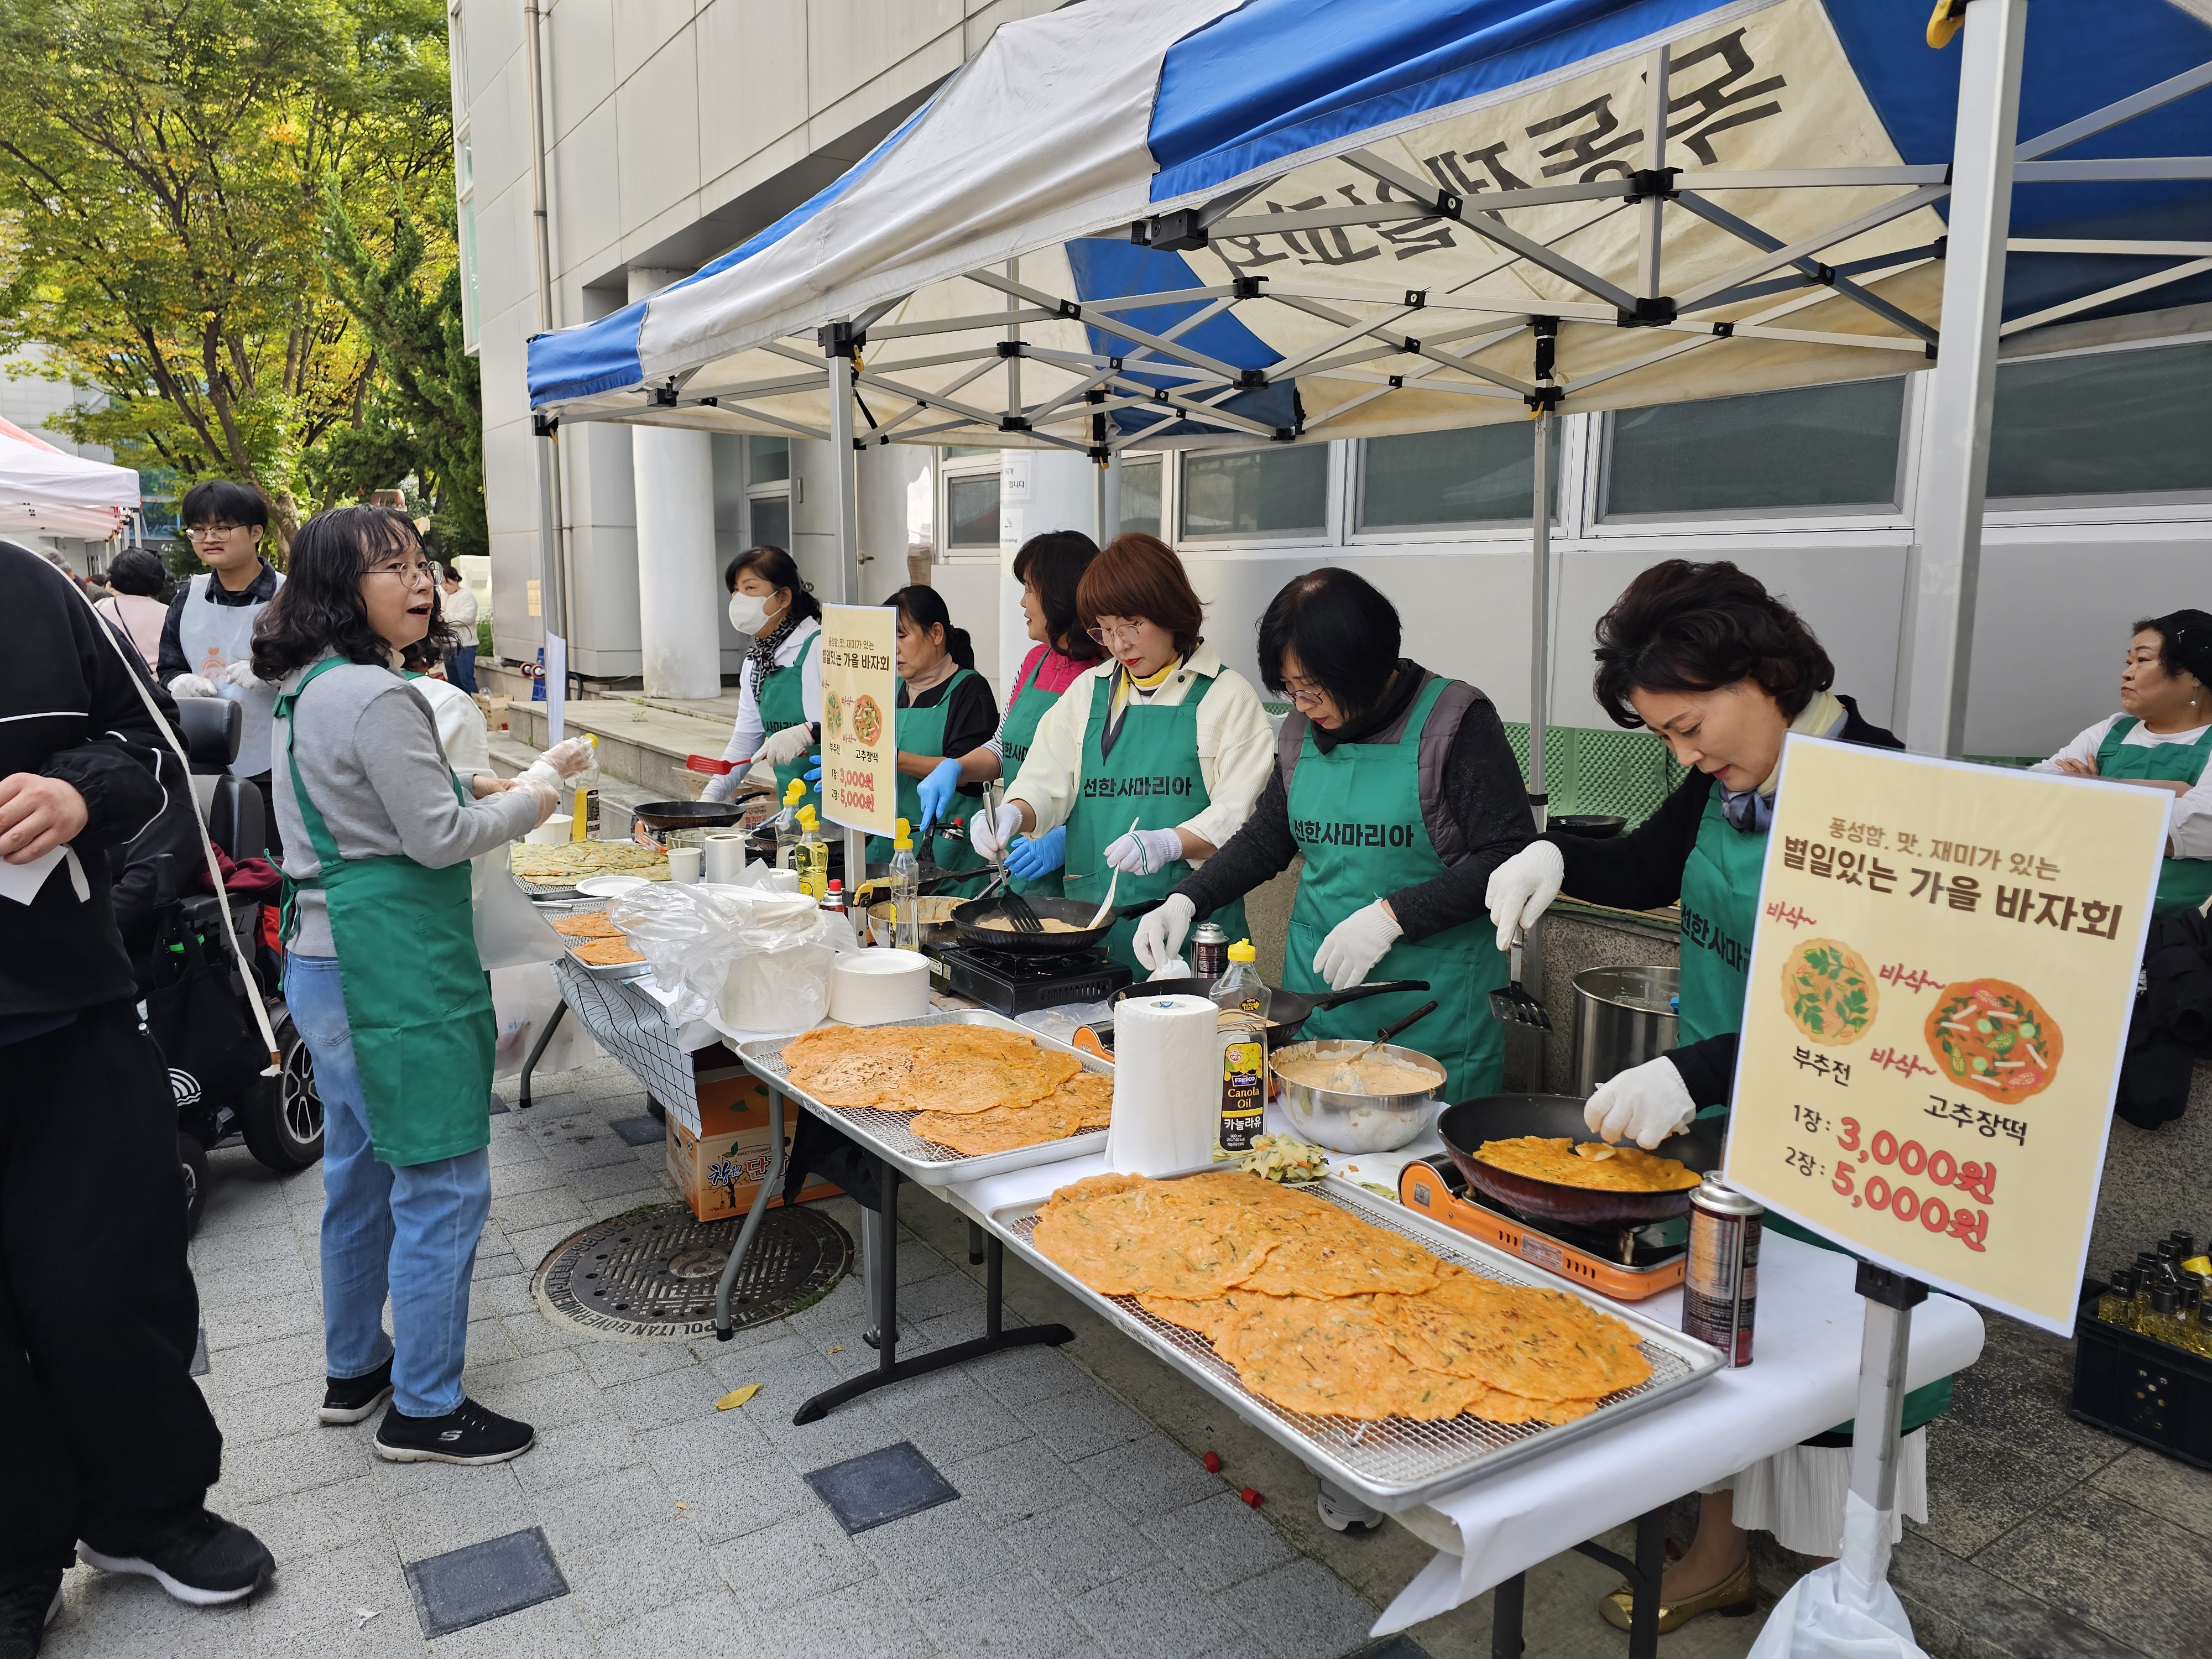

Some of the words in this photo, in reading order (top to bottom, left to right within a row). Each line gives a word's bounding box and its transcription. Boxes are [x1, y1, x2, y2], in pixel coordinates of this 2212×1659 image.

[846, 639, 862, 649] 재미가
[863, 640, 874, 650] 있는
[843, 653, 859, 669] 가을
[862, 654, 889, 671] 바자회
[855, 750, 878, 763] 고추장떡
[840, 768, 874, 791] 3,000원
[1084, 776, 1192, 797] 선한사마리아
[840, 789, 874, 812] 5,000원
[1294, 820, 1414, 847] 선한사마리아
[1829, 817, 1889, 850] 풍성함.
[1897, 831, 1922, 857] 맛.
[1929, 838, 2002, 871] 재미가
[2008, 853, 2060, 881] 있는
[1784, 836, 1898, 894] 별일있는
[1910, 868, 1982, 913] 가을
[1995, 885, 2122, 941] 바자회
[1766, 901, 1817, 929] 바삭~
[1879, 963, 1947, 995] 바삭~
[1793, 1045, 1851, 1087] 부추전
[1870, 1047, 1937, 1079] 바삭~
[1228, 1086, 1260, 1098] Canola
[1237, 1098, 1251, 1108] Oil
[1224, 1116, 1261, 1131] 카놀라유
[1923, 1094, 2027, 1146] 고추장떡
[1794, 1104, 1831, 1133] 1장:
[1838, 1117, 1997, 1204] 3,000원
[1785, 1146, 1825, 1176] 2장:
[1832, 1160, 1989, 1252] 5,000원
[548, 1289, 632, 1333] GOVERNMENT
[629, 1299, 781, 1336] METRPOLITAN
